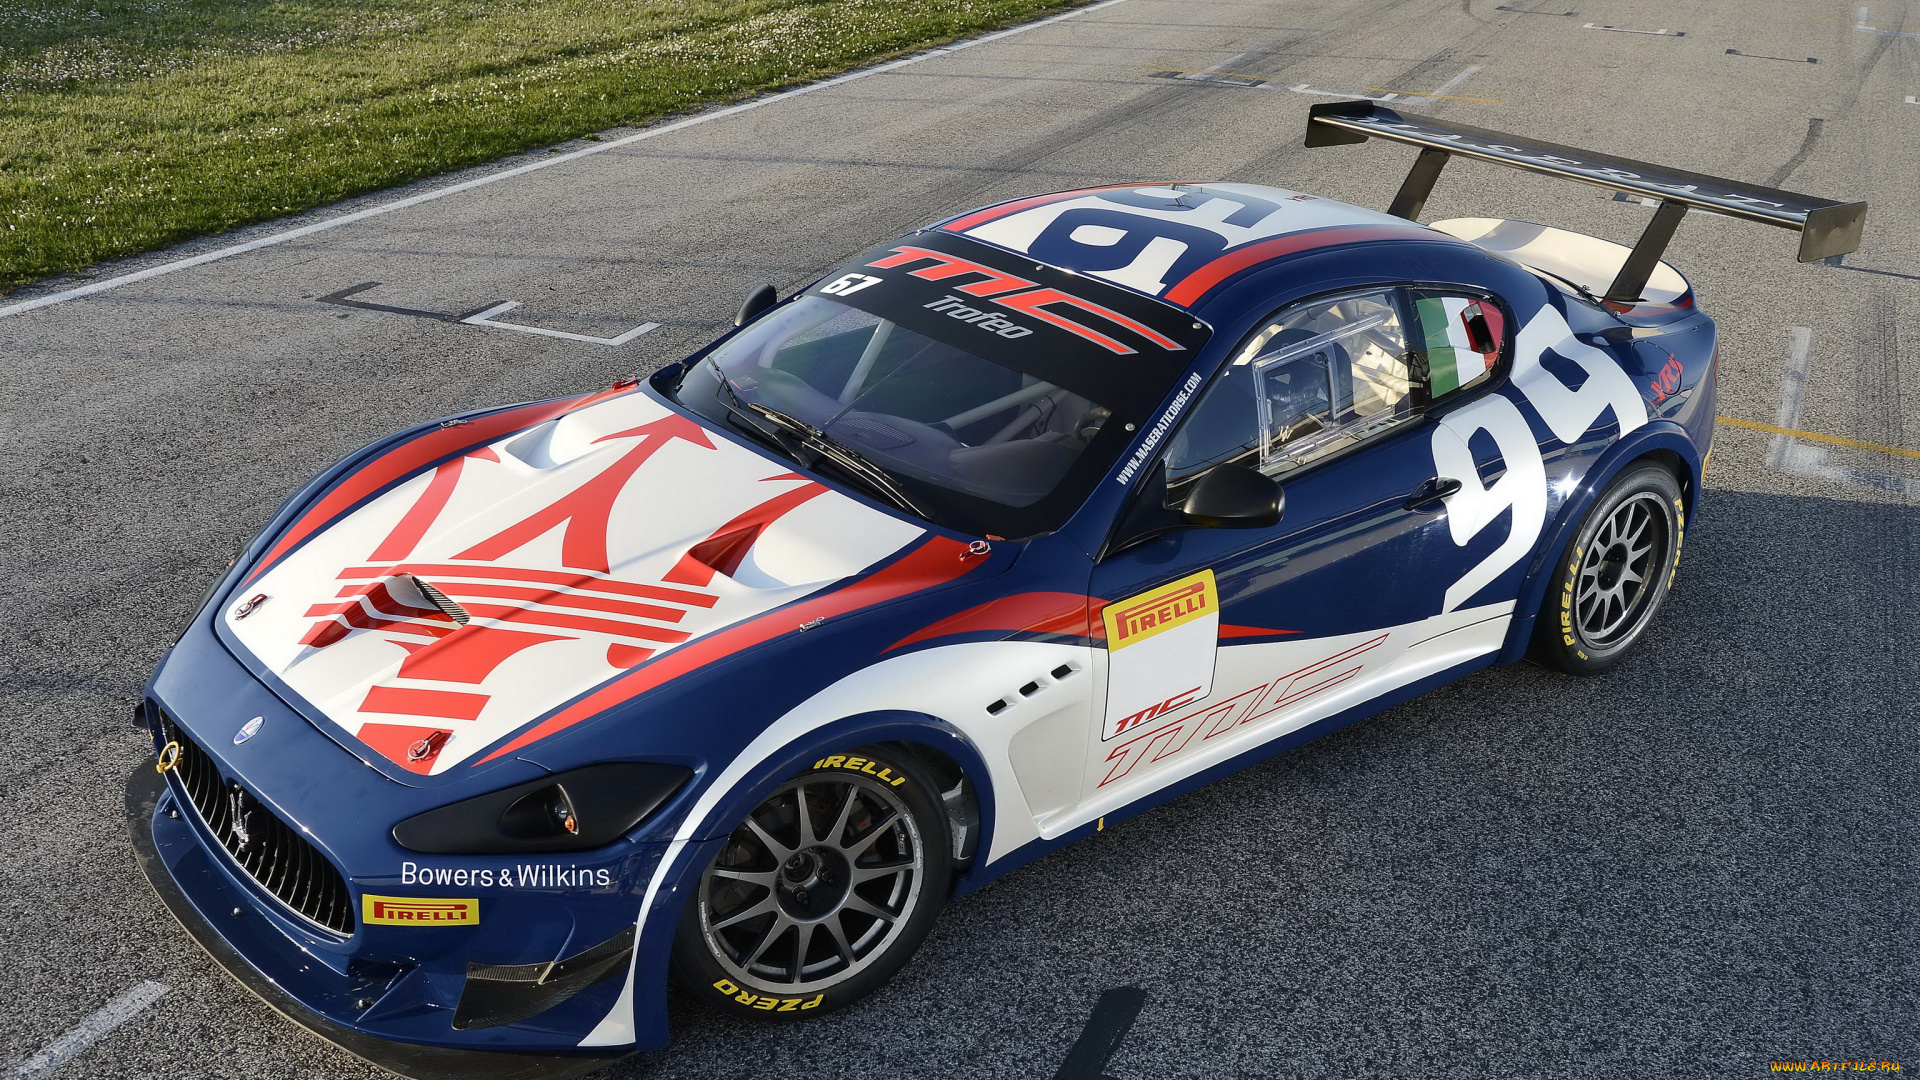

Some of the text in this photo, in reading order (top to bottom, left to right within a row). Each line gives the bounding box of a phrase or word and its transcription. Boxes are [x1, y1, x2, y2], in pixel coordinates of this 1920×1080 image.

[819, 273, 884, 297] 67
[922, 295, 1034, 339] Trofeo
[1116, 371, 1202, 486] WWW.MASERATICORSE.COM
[1115, 581, 1206, 641] PIRELLI
[1561, 546, 1583, 646] PIRELLI
[813, 755, 906, 787] IRELLI
[401, 861, 611, 888] Bowers & Wilkins
[373, 901, 468, 921] PIRELLI
[712, 978, 825, 1012] PZERO
